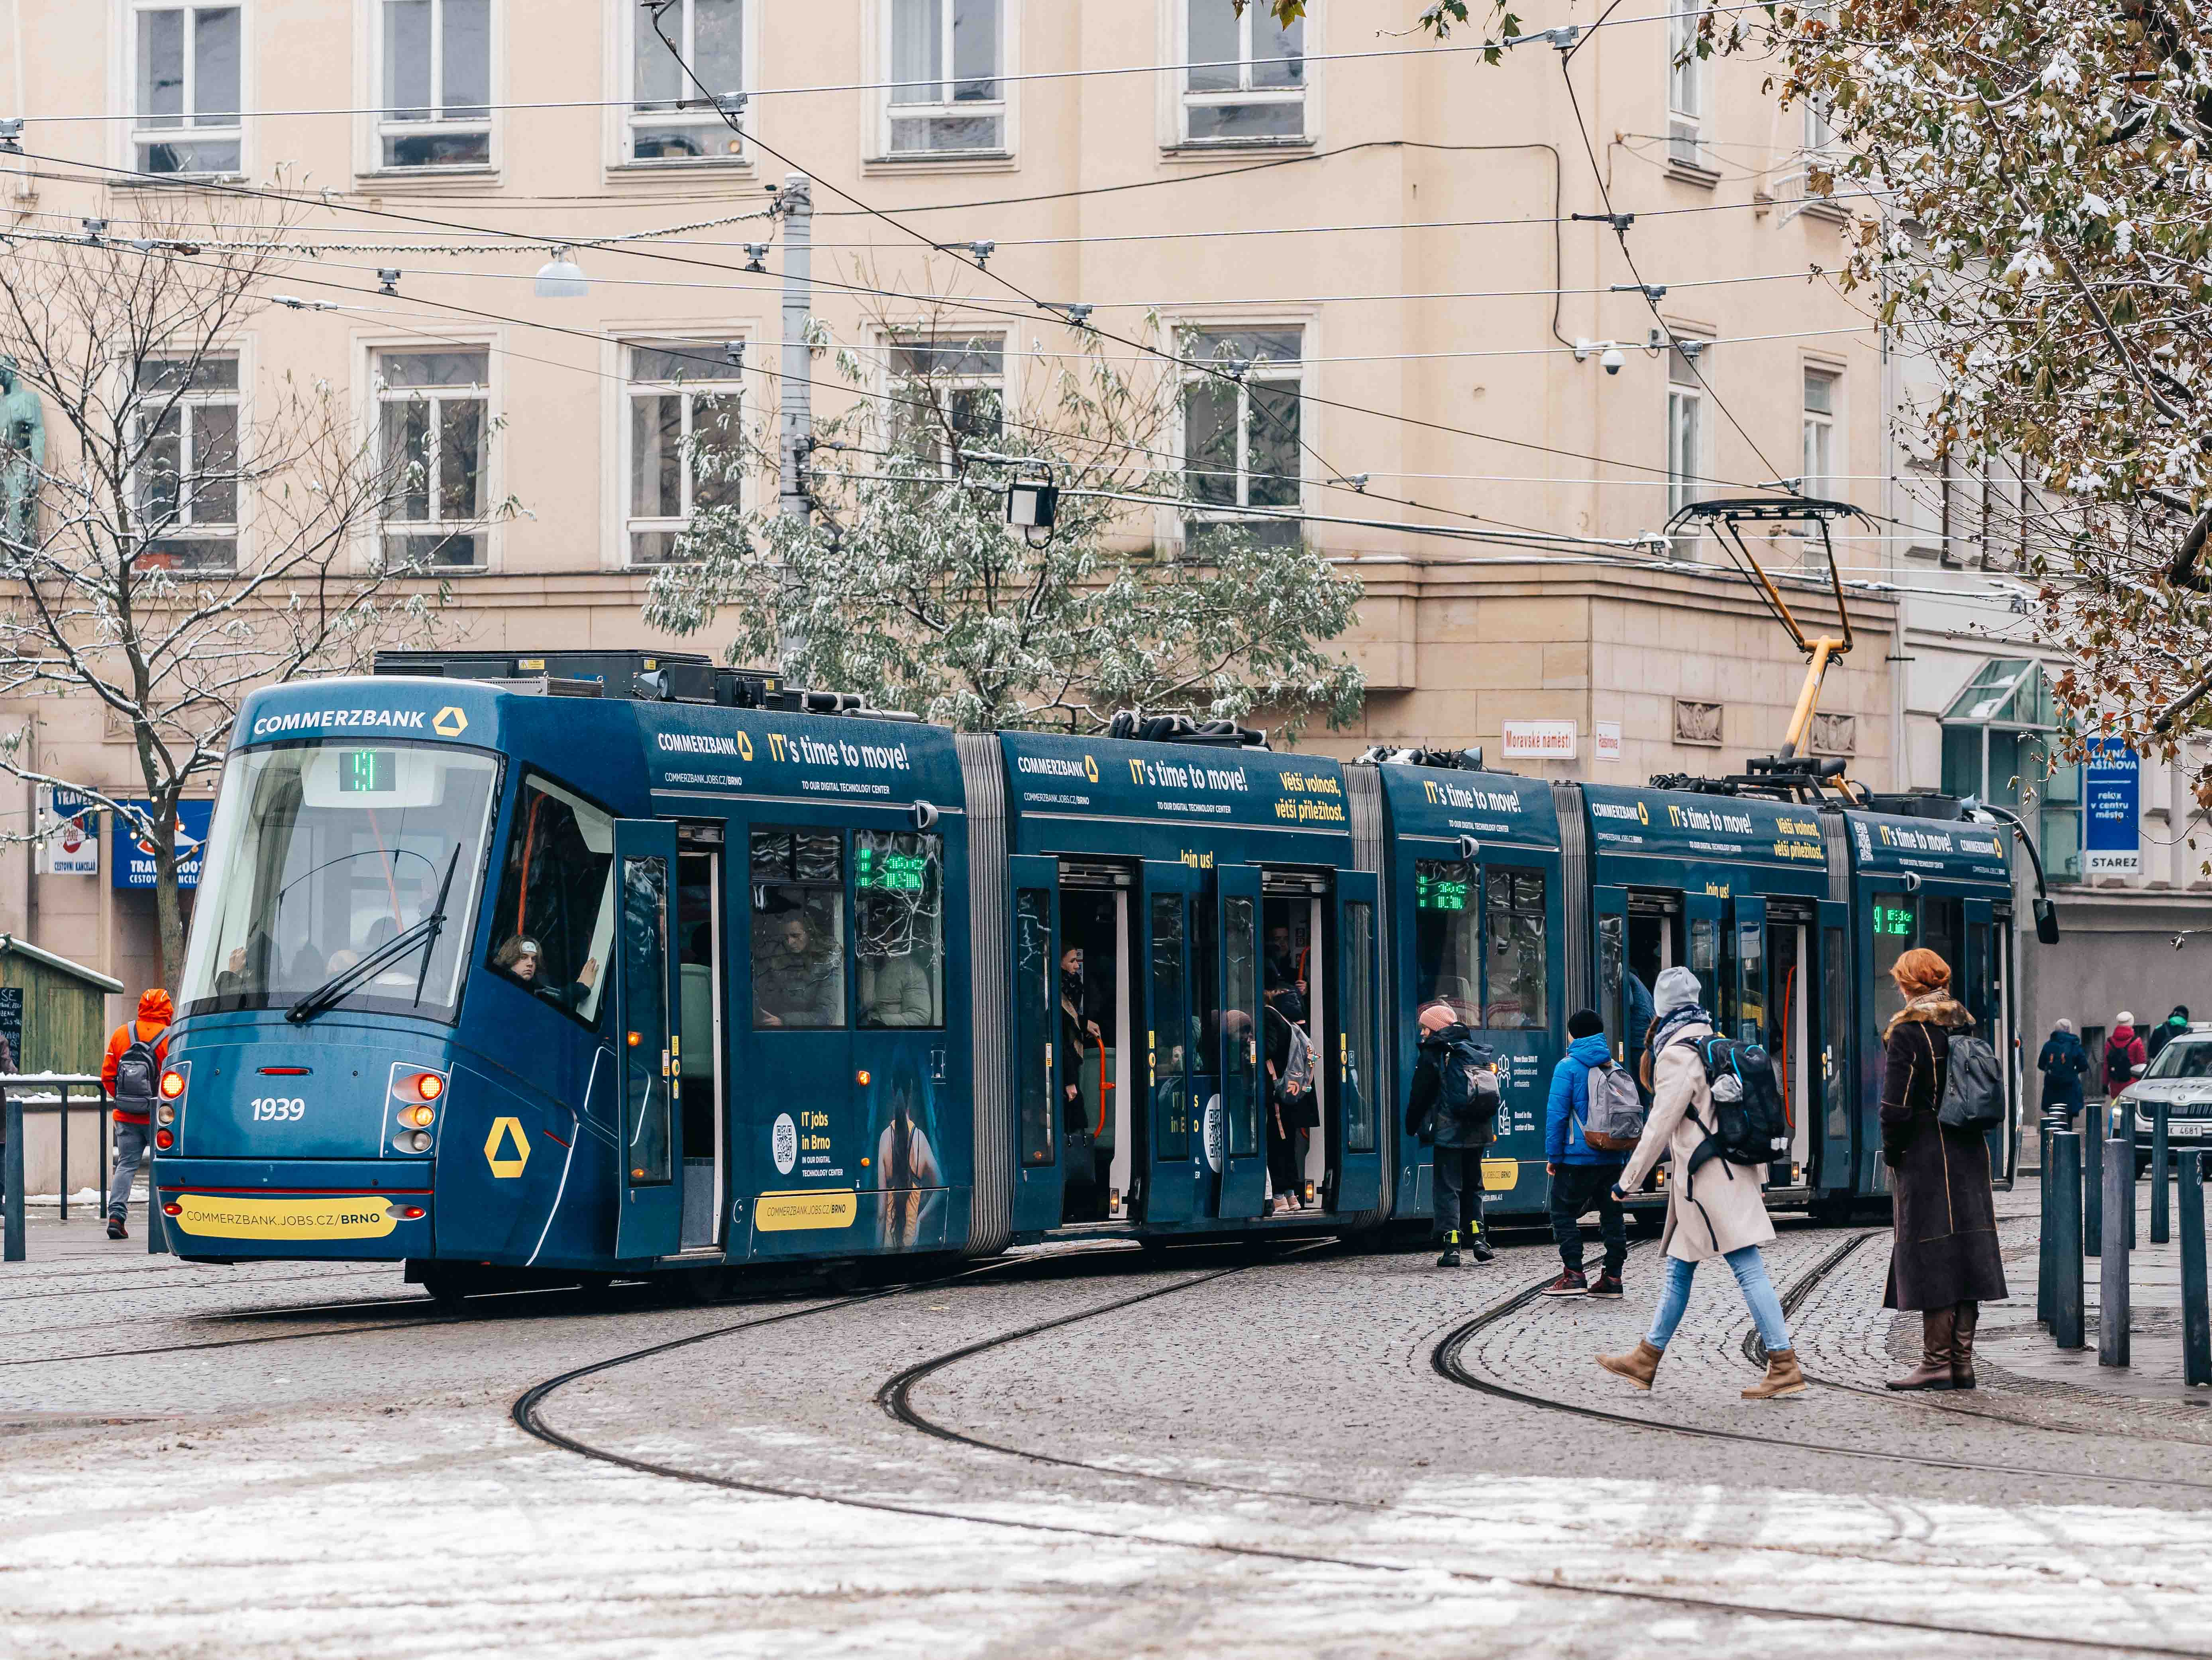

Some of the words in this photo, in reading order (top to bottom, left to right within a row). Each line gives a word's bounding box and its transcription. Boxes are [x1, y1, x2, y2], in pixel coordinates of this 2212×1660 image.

[254, 710, 426, 735] COMMERZBANK
[658, 733, 737, 755] COMMERZBANK
[1506, 731, 1540, 748] Moravské
[1543, 731, 1571, 749] náměstí
[767, 733, 800, 763] IT's
[800, 735, 839, 765] time
[839, 739, 859, 767] to
[861, 743, 910, 770] move!
[1018, 757, 1085, 777] COMMERZBANK
[1129, 759, 1156, 786] IT's
[1156, 760, 1188, 788] time
[1188, 764, 1205, 789] to
[1206, 766, 1248, 791] move!
[665, 772, 742, 786] COMMERZBANK.JOBS.CZ/BRNO
[801, 780, 809, 790] TO
[810, 782, 820, 791] OUR
[820, 782, 839, 792] DIGITAL
[840, 783, 871, 793] TECHNOLOGY
[871, 784, 889, 794] CENTER
[1279, 771, 1305, 792] Větší
[1305, 774, 1341, 797] volnost,
[1024, 792, 1089, 805] COMMERZBANK.JOBS.CZ/BRNO
[1423, 780, 1447, 806] IT's
[1446, 783, 1474, 809] time
[1472, 787, 1487, 810] to
[1487, 790, 1521, 813] move!
[2098, 791, 2122, 800] relax
[1157, 802, 1163, 810] TO
[1163, 802, 1173, 810] OUR
[1173, 802, 1188, 811] DIGITAL
[1188, 804, 1215, 813] TECHNOLOGY
[1215, 805, 1231, 813] CENTER
[1275, 798, 1297, 818] větší
[1298, 800, 1345, 822] příležitost.
[1592, 803, 1639, 820] COMMERZBANK
[1462, 821, 1474, 829] DIGITAL
[1474, 823, 1496, 831] TECHNOLOGY
[1668, 805, 1688, 828] IT's
[1687, 807, 1711, 830] time
[1710, 810, 1722, 831] to
[1723, 813, 1753, 834] move!
[1776, 817, 1794, 835] Větší
[1794, 819, 1820, 840] volnost,
[1879, 825, 1897, 846] IT's
[1896, 827, 1917, 848] time
[1915, 830, 1927, 850] to
[1927, 833, 1953, 853] move!
[1773, 839, 1790, 857] větší
[1790, 841, 1824, 860] příležitost.
[54, 858, 74, 871] CESTOVNÍ
[1181, 849, 1198, 868] Join
[1200, 851, 1213, 869] us!
[2092, 858, 2138, 867] STAREZ
[130, 874, 157, 884] CESTOV
[1719, 883, 1729, 899] us!
[251, 1098, 305, 1121] 1939
[801, 1111, 809, 1126] IT
[811, 1111, 828, 1130] jobs
[802, 1135, 809, 1150] in
[811, 1135, 830, 1150] Brno
[186, 1210, 380, 1227] COMMERZBANK.JOBS.CZ/BRNO
[767, 1204, 846, 1217] COMMERZBANK.JOBS.CZ/BRNO
